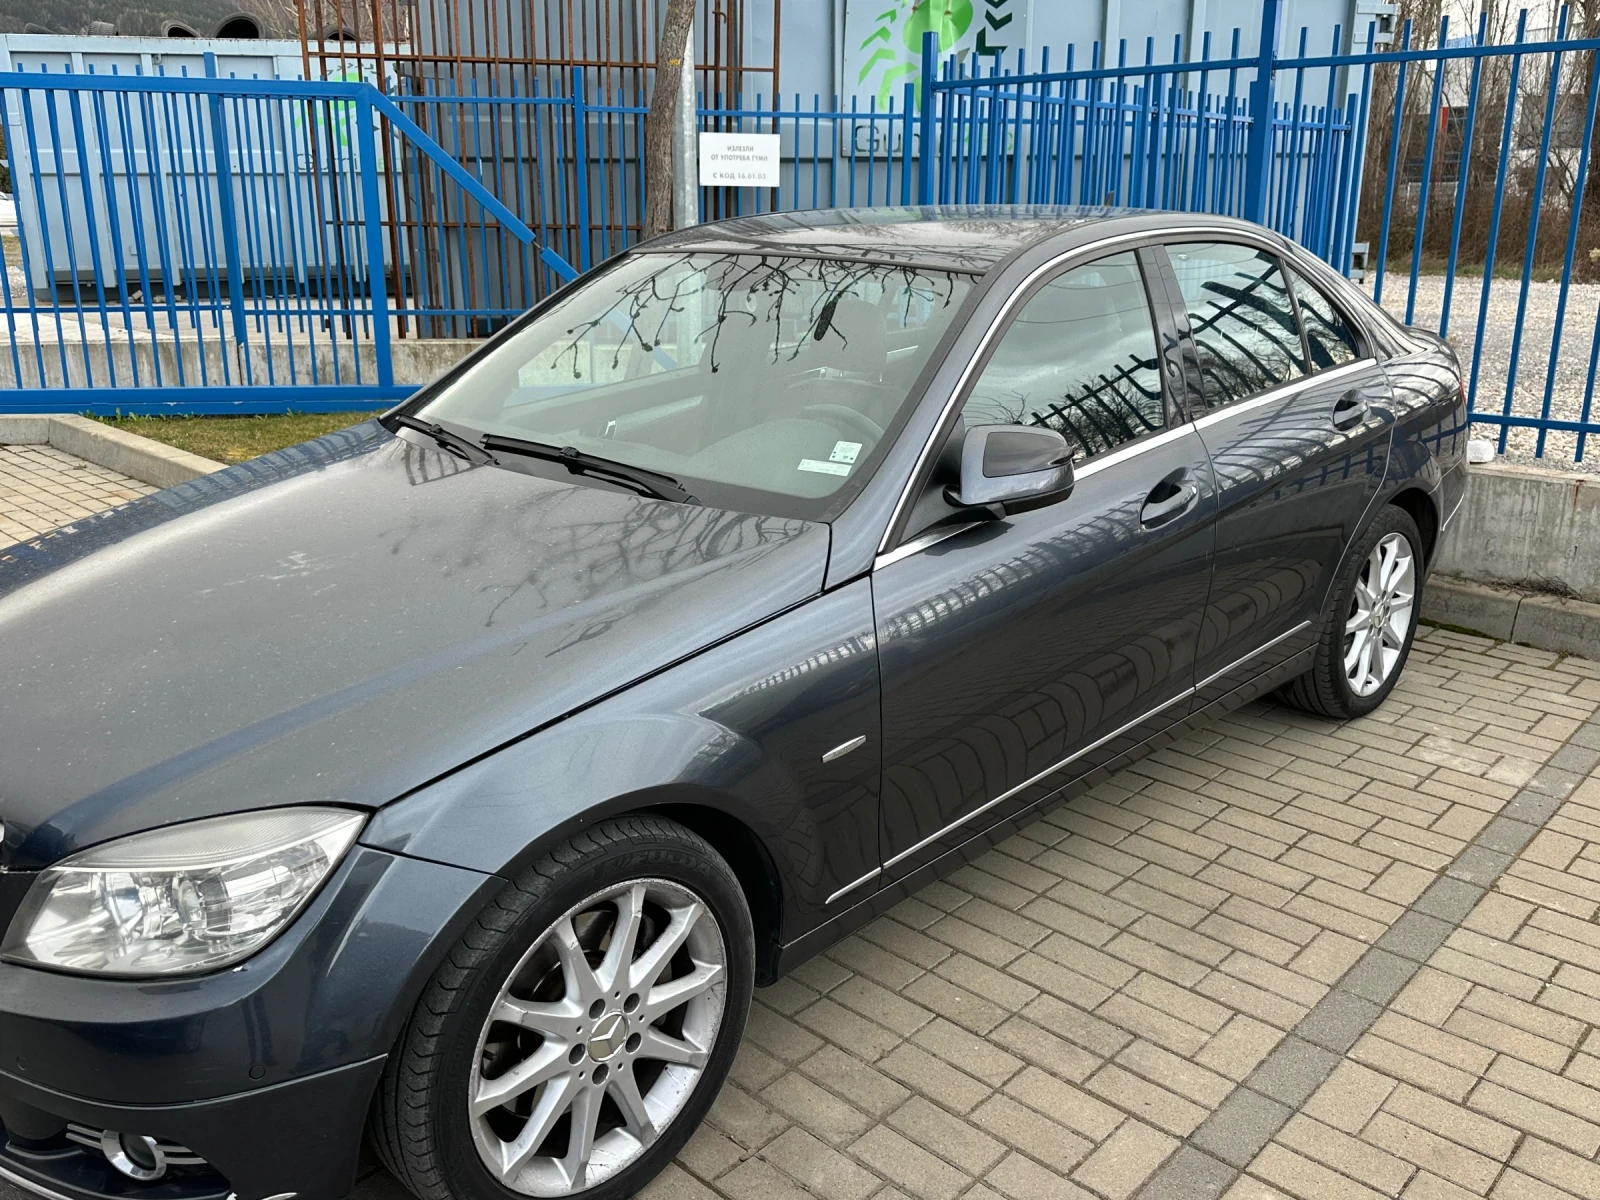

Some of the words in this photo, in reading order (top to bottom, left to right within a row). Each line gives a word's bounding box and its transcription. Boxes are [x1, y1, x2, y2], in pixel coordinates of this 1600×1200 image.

[720, 172, 735, 180] КОД
[738, 172, 766, 180] 16.01.03
[632, 849, 712, 877] FULDA
